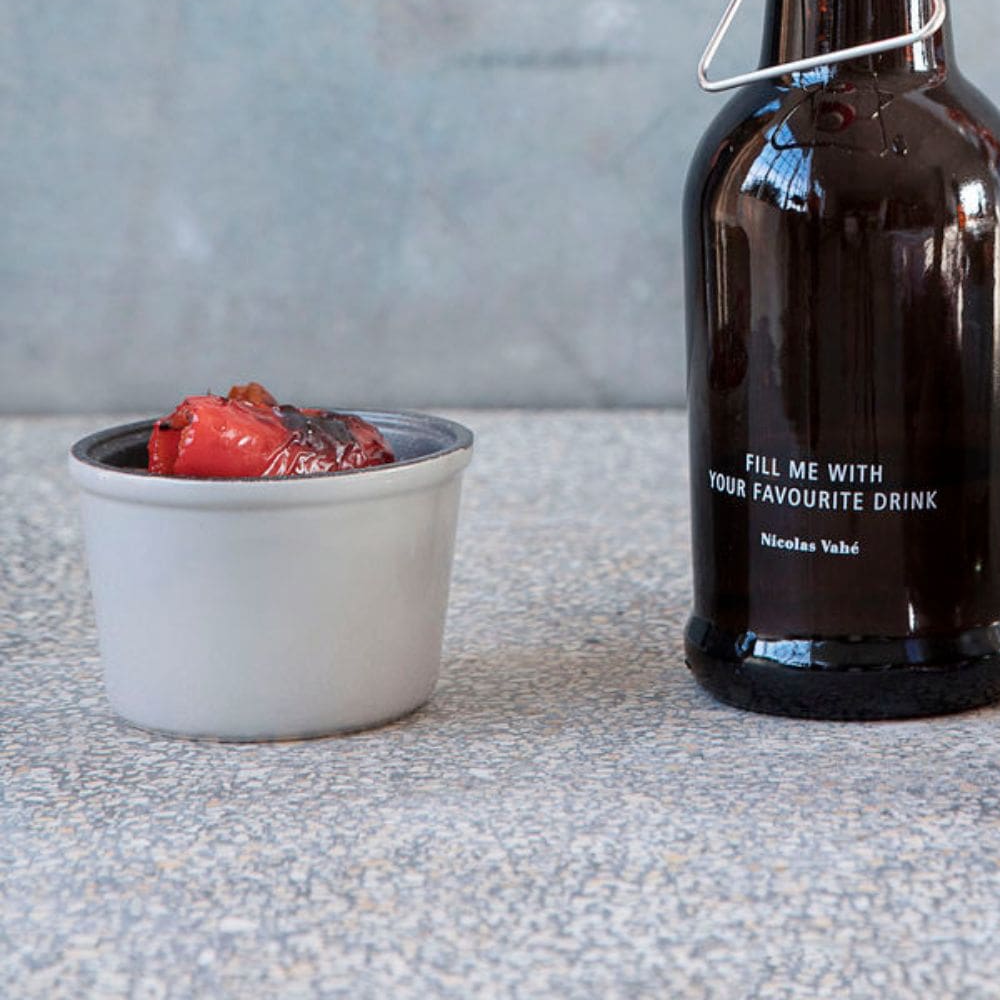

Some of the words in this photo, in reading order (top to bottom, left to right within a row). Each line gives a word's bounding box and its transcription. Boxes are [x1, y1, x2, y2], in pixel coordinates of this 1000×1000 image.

[746, 454, 780, 477] FILL
[789, 460, 818, 481] ME
[828, 463, 883, 483] WITH
[709, 470, 746, 498] YOUR
[753, 483, 864, 511] FAVOURITE
[874, 491, 938, 511] DRINK
[760, 532, 816, 553] Nicolas
[821, 539, 860, 556] Vahé
